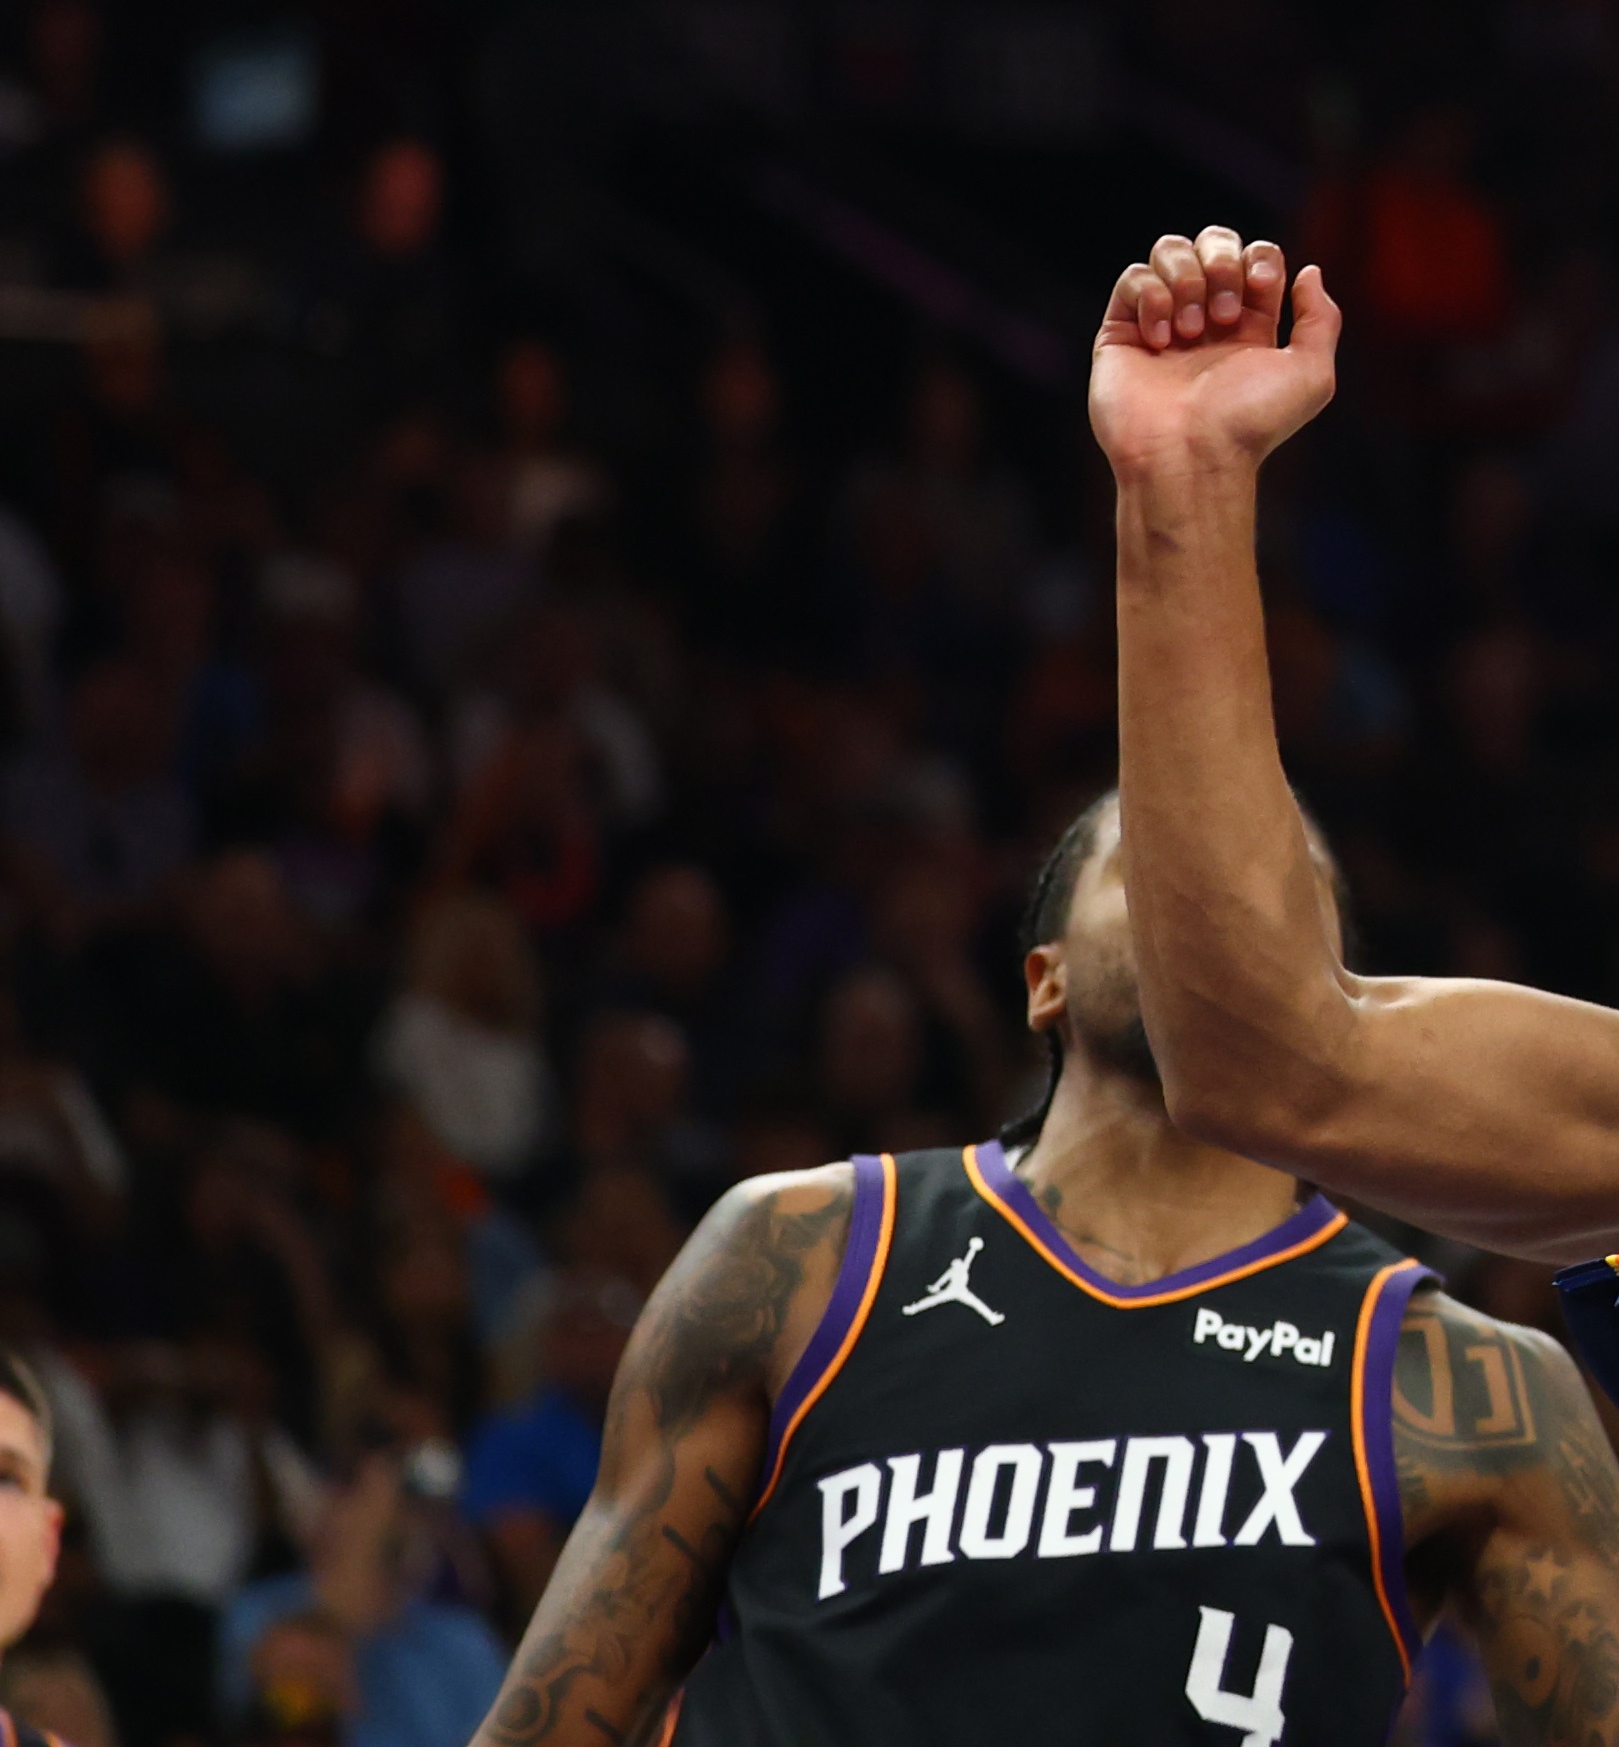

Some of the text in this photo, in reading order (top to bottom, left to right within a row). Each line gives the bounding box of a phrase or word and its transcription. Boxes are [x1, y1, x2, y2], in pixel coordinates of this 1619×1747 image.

[1194, 1308, 1335, 1367] PayPal
[817, 1430, 1332, 1601] PHOENIX
[1184, 1605, 1294, 1747] 4
